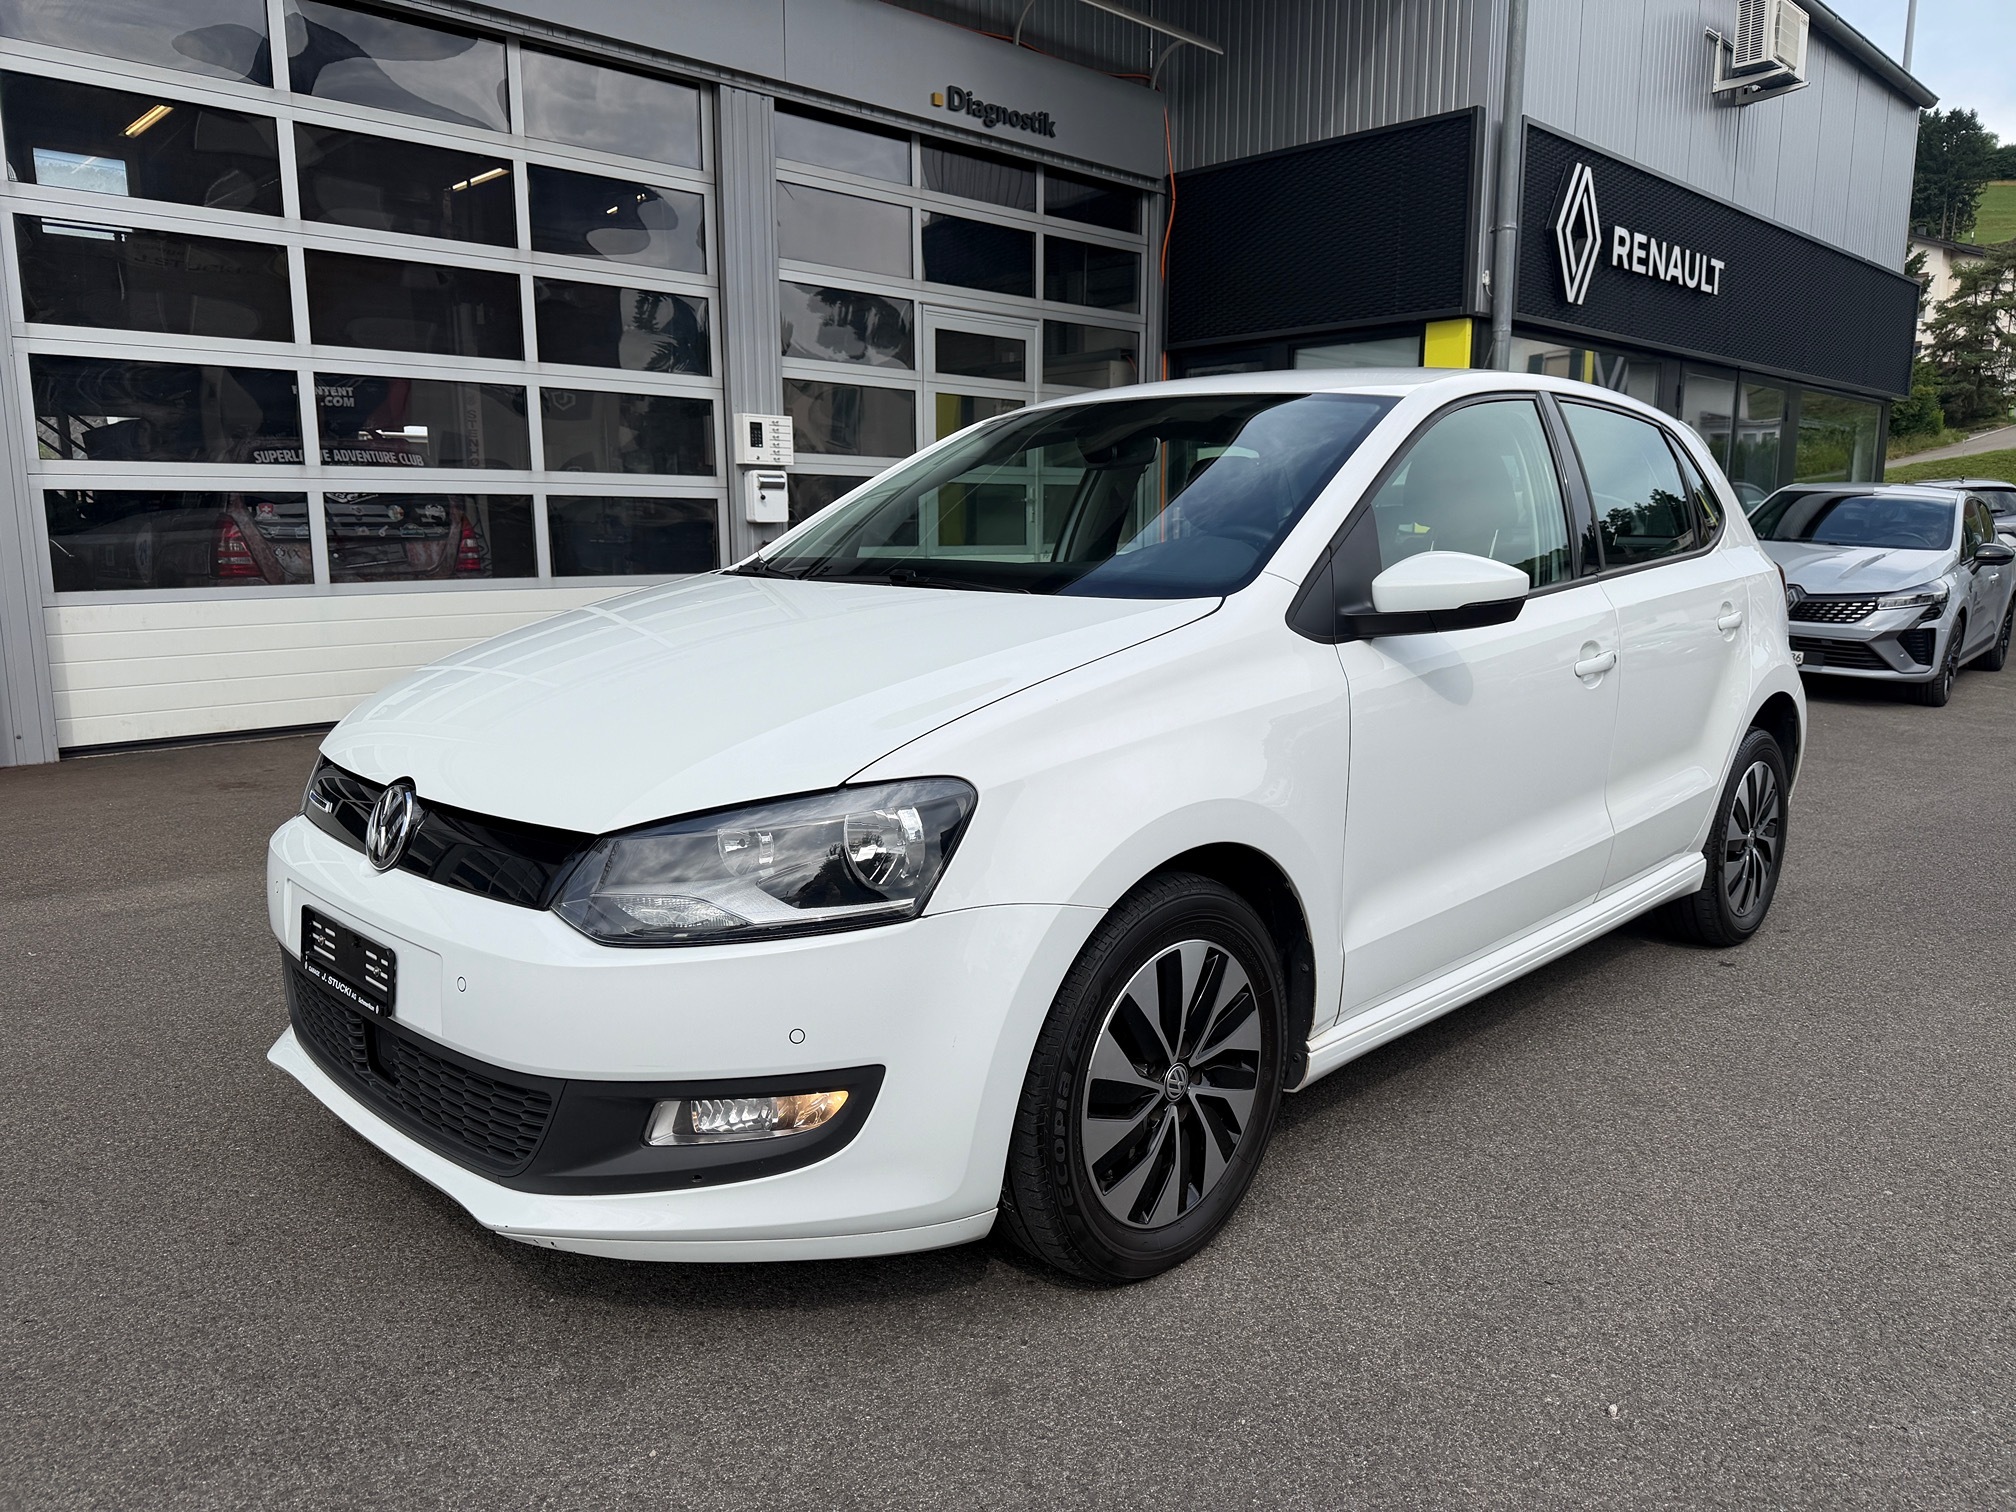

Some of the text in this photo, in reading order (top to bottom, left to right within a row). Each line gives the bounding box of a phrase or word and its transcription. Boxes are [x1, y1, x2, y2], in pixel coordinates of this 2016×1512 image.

[946, 85, 1056, 138] Diagnostik
[1612, 225, 1725, 295] RENAULT
[320, 396, 354, 407] .COM
[333, 449, 398, 464] ADVENTURE
[399, 452, 424, 466] CLUB
